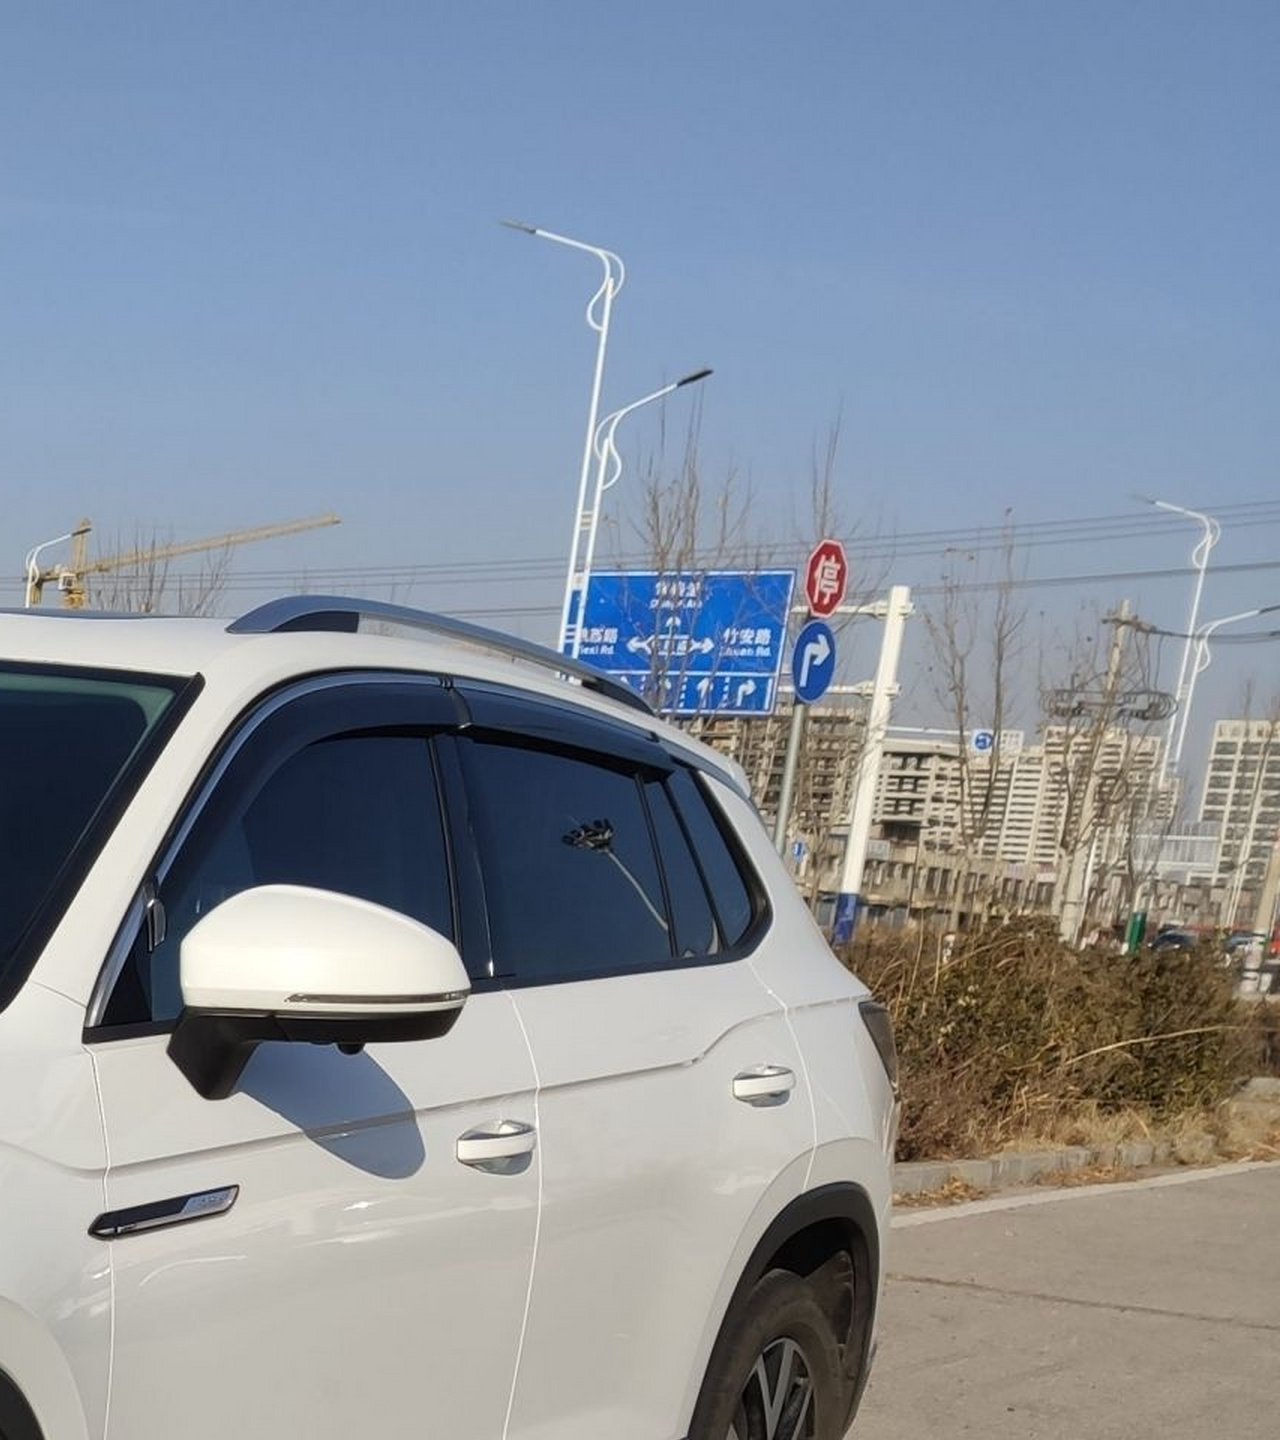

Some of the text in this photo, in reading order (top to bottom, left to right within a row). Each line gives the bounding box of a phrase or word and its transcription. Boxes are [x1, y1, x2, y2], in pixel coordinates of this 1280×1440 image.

[813, 553, 842, 606] 停
[722, 627, 772, 646] 竹安路
